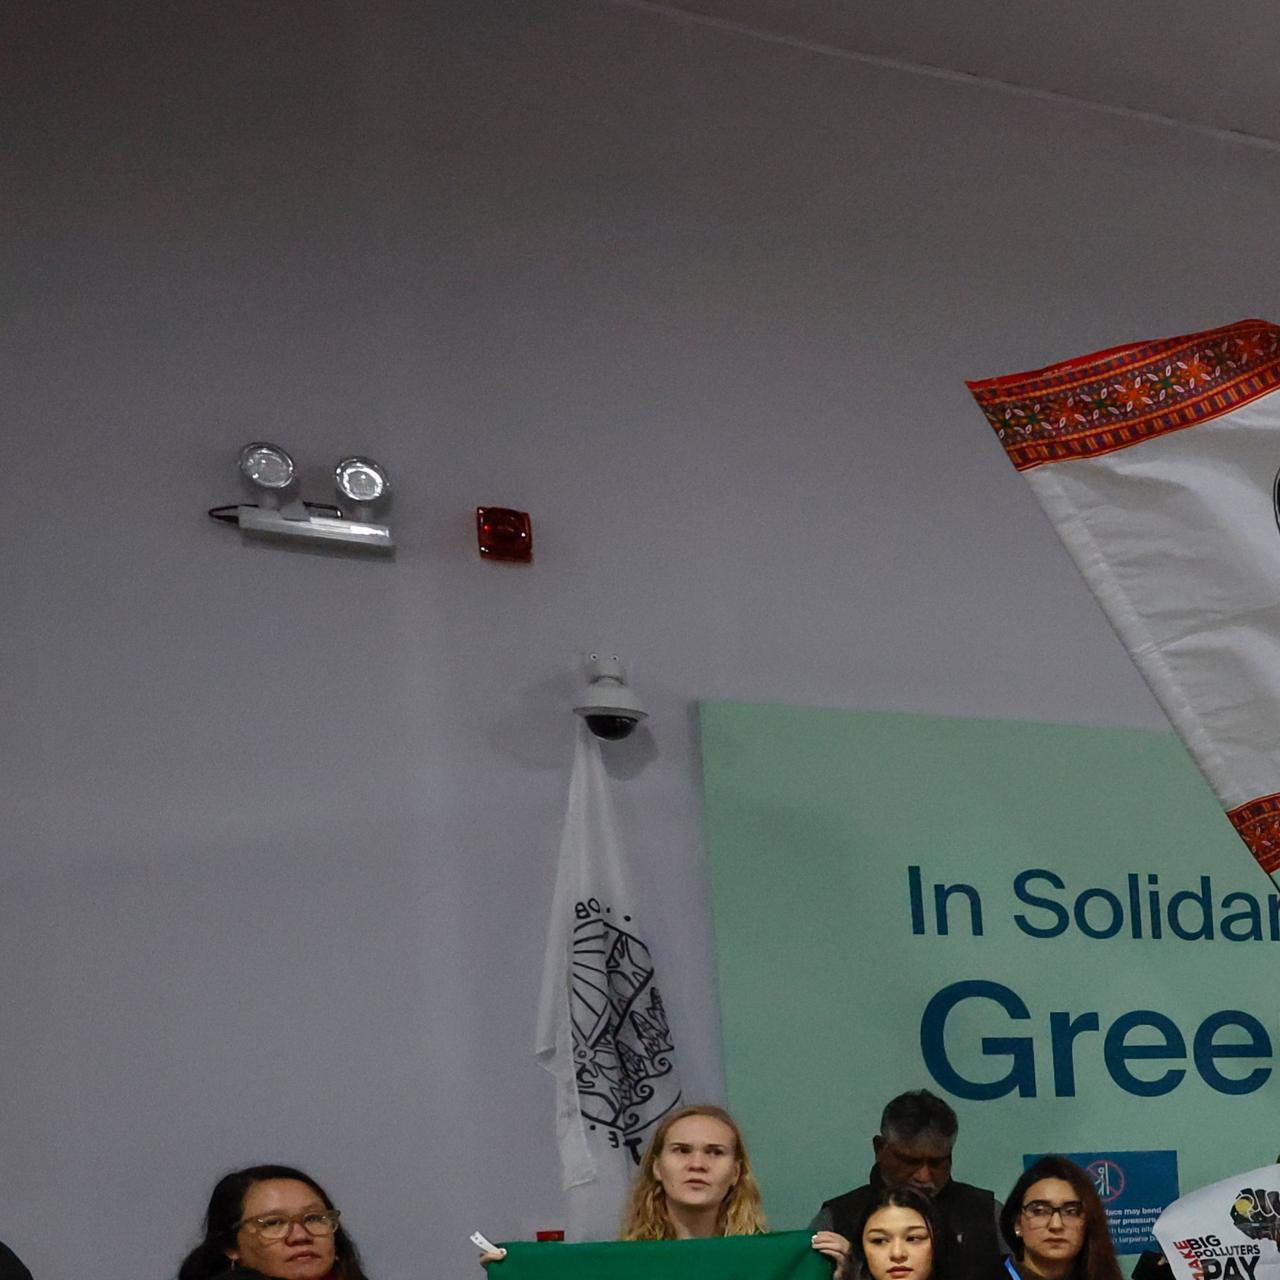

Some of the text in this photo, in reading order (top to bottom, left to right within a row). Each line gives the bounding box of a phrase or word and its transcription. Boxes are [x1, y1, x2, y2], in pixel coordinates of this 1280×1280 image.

[908, 865, 983, 936] In
[1187, 1235, 1221, 1250] BIG
[1194, 1244, 1260, 1258] POLLUTERS
